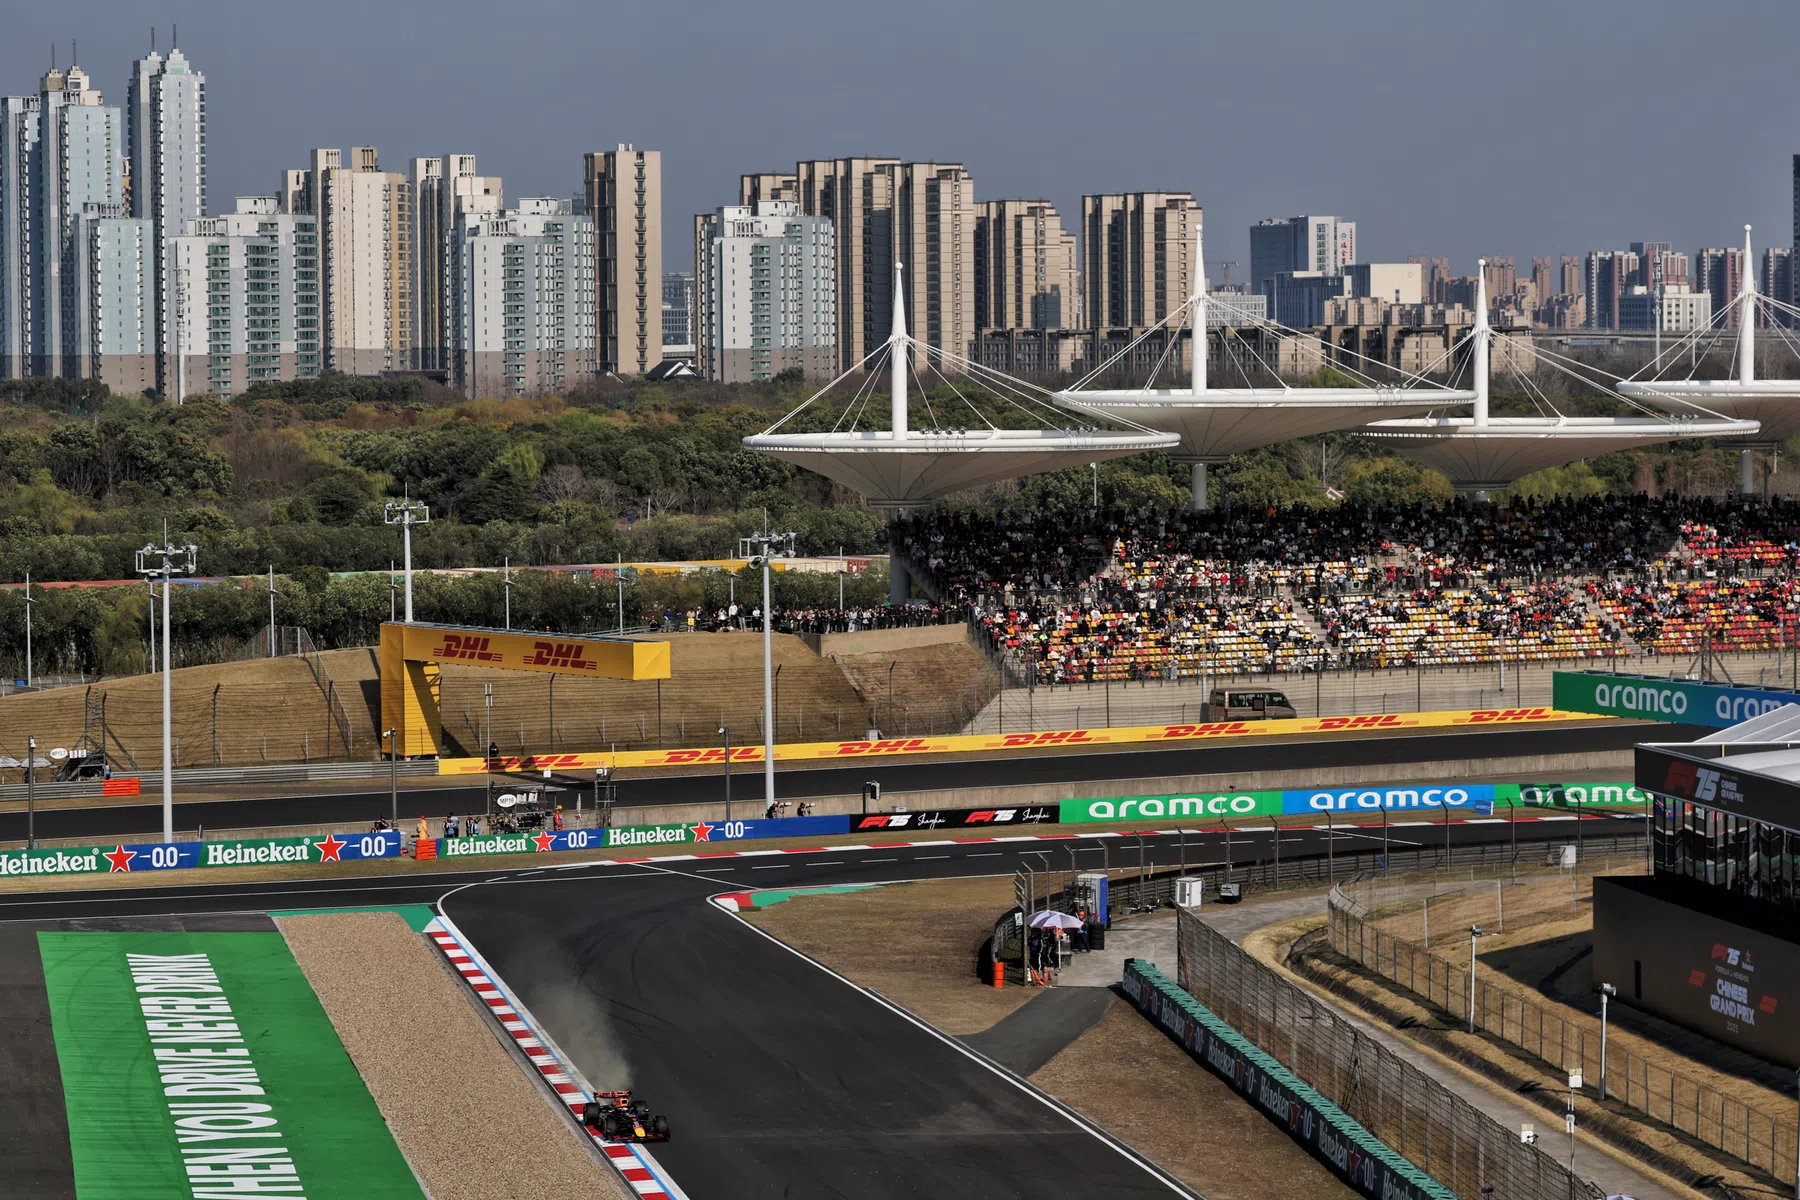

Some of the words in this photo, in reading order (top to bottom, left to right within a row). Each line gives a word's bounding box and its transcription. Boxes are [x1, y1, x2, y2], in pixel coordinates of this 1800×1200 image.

[443, 634, 494, 662] DHL
[533, 641, 587, 669] DHL
[1595, 683, 1687, 715] aramco
[1317, 715, 1403, 730] DHL
[1469, 708, 1551, 722] DHL
[1001, 730, 1095, 746] DHL
[1162, 722, 1250, 738] DHL
[664, 747, 764, 764] DHL
[836, 739, 931, 755] DHL
[479, 754, 588, 771] DHL
[1694, 767, 1721, 801] 75
[1088, 795, 1256, 818] aramco
[1309, 788, 1468, 810] aramco
[887, 814, 912, 827] 75
[993, 809, 1017, 822] 75
[1726, 947, 1740, 966] 75
[125, 953, 223, 993] DRINK
[1716, 978, 1748, 1004] CHINESE
[139, 996, 244, 1043] NEVER
[1710, 994, 1736, 1018] GRAND
[1736, 1004, 1755, 1026] PRIX
[153, 1048, 266, 1096] DRIVE
[1259, 1074, 1290, 1121] Heineken
[167, 1102, 282, 1143] YOU
[1318, 1119, 1347, 1171] Heineken
